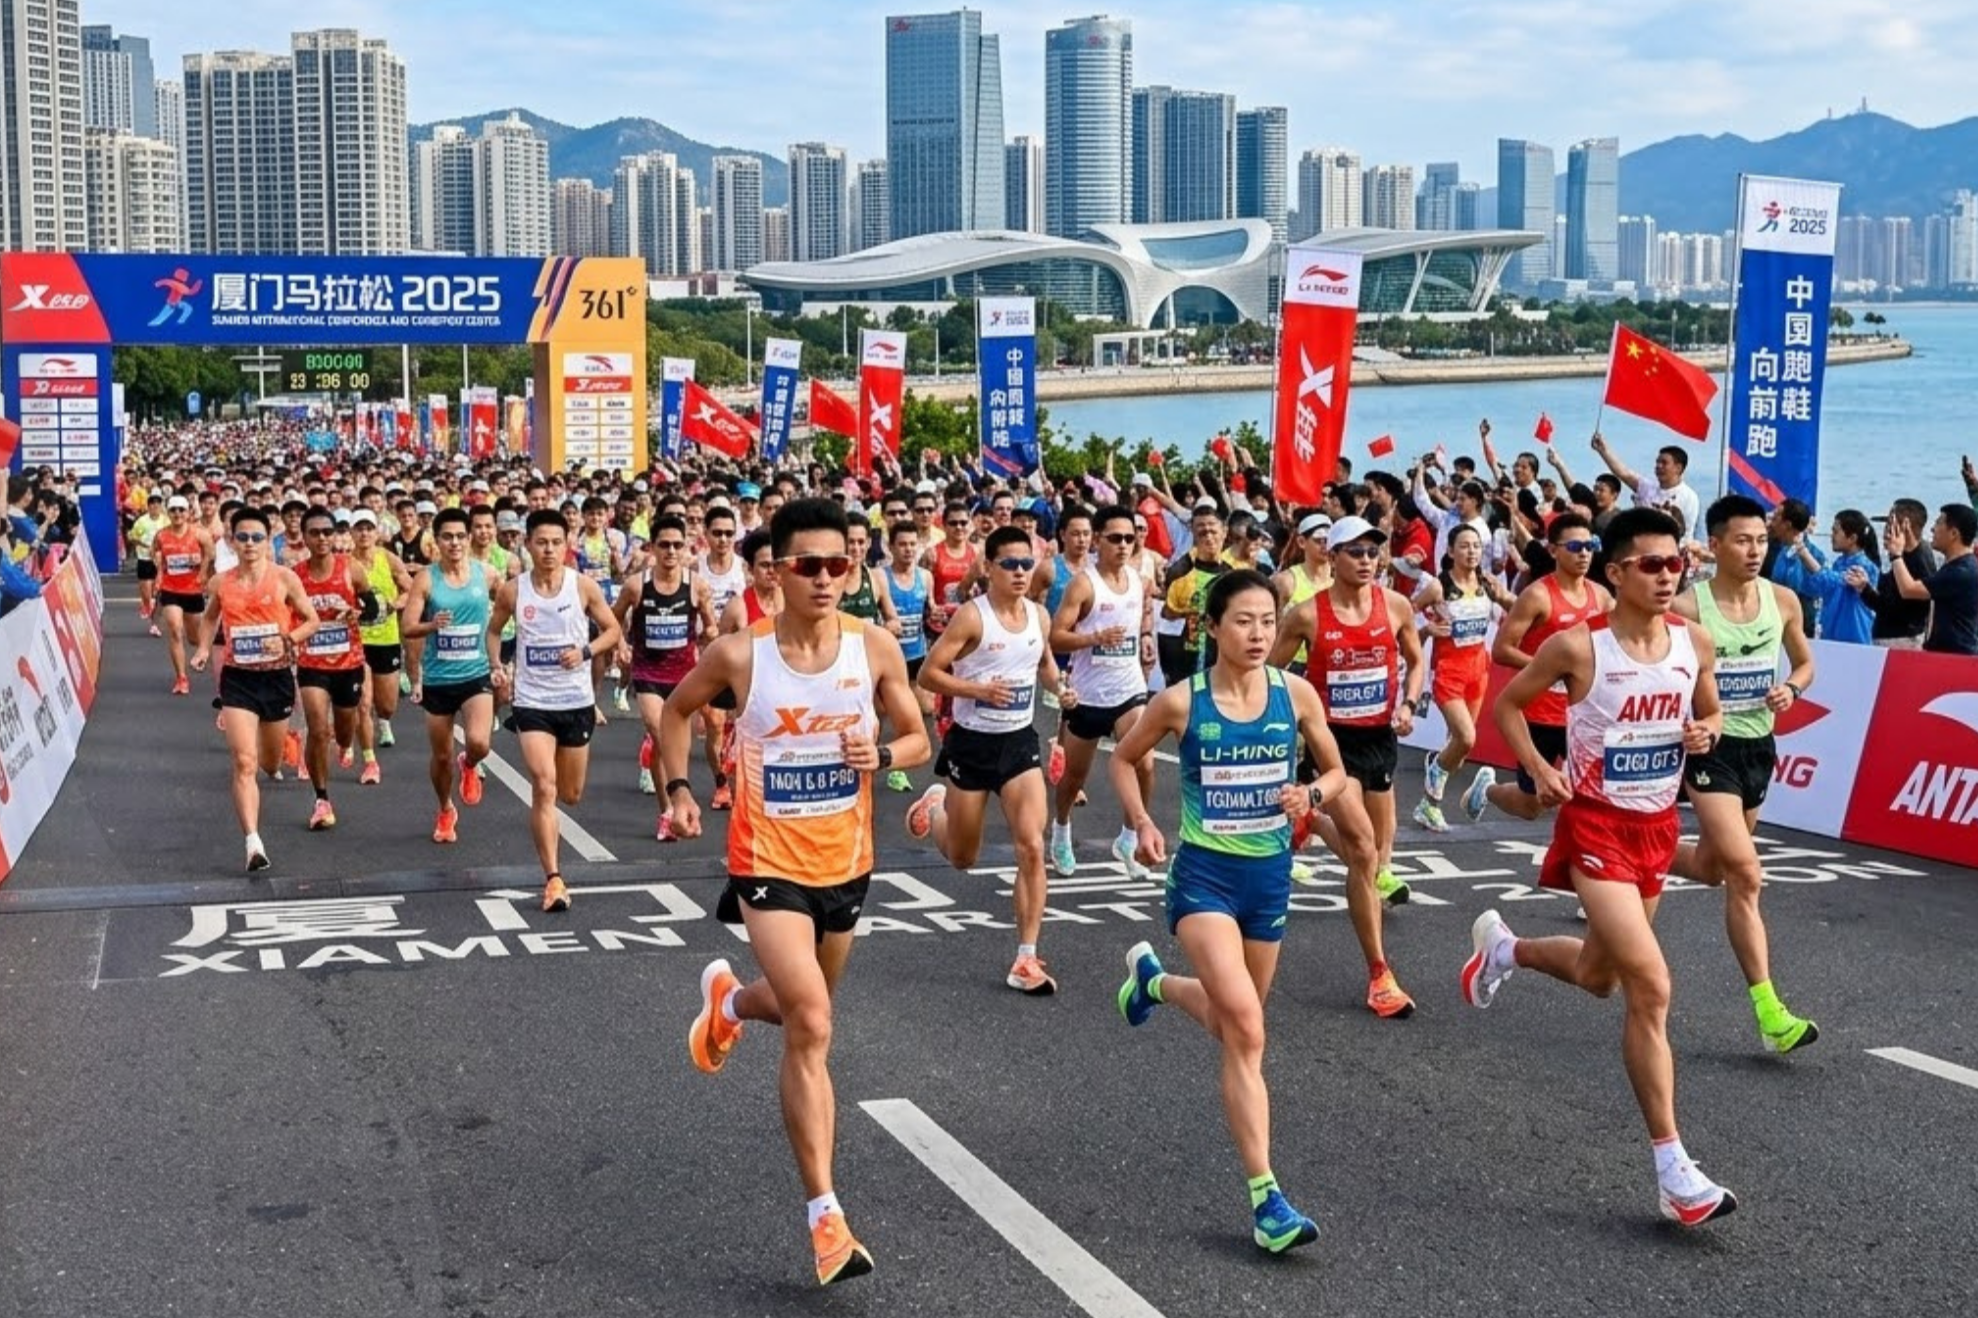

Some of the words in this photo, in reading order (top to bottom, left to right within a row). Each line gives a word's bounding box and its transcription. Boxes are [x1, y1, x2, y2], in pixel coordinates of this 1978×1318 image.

[1789, 218, 1827, 235] 2025
[212, 273, 394, 311] 厦门马拉松
[402, 276, 500, 311] 2025
[1617, 692, 1682, 722] ANTA
[159, 927, 686, 977] XIAMEN
